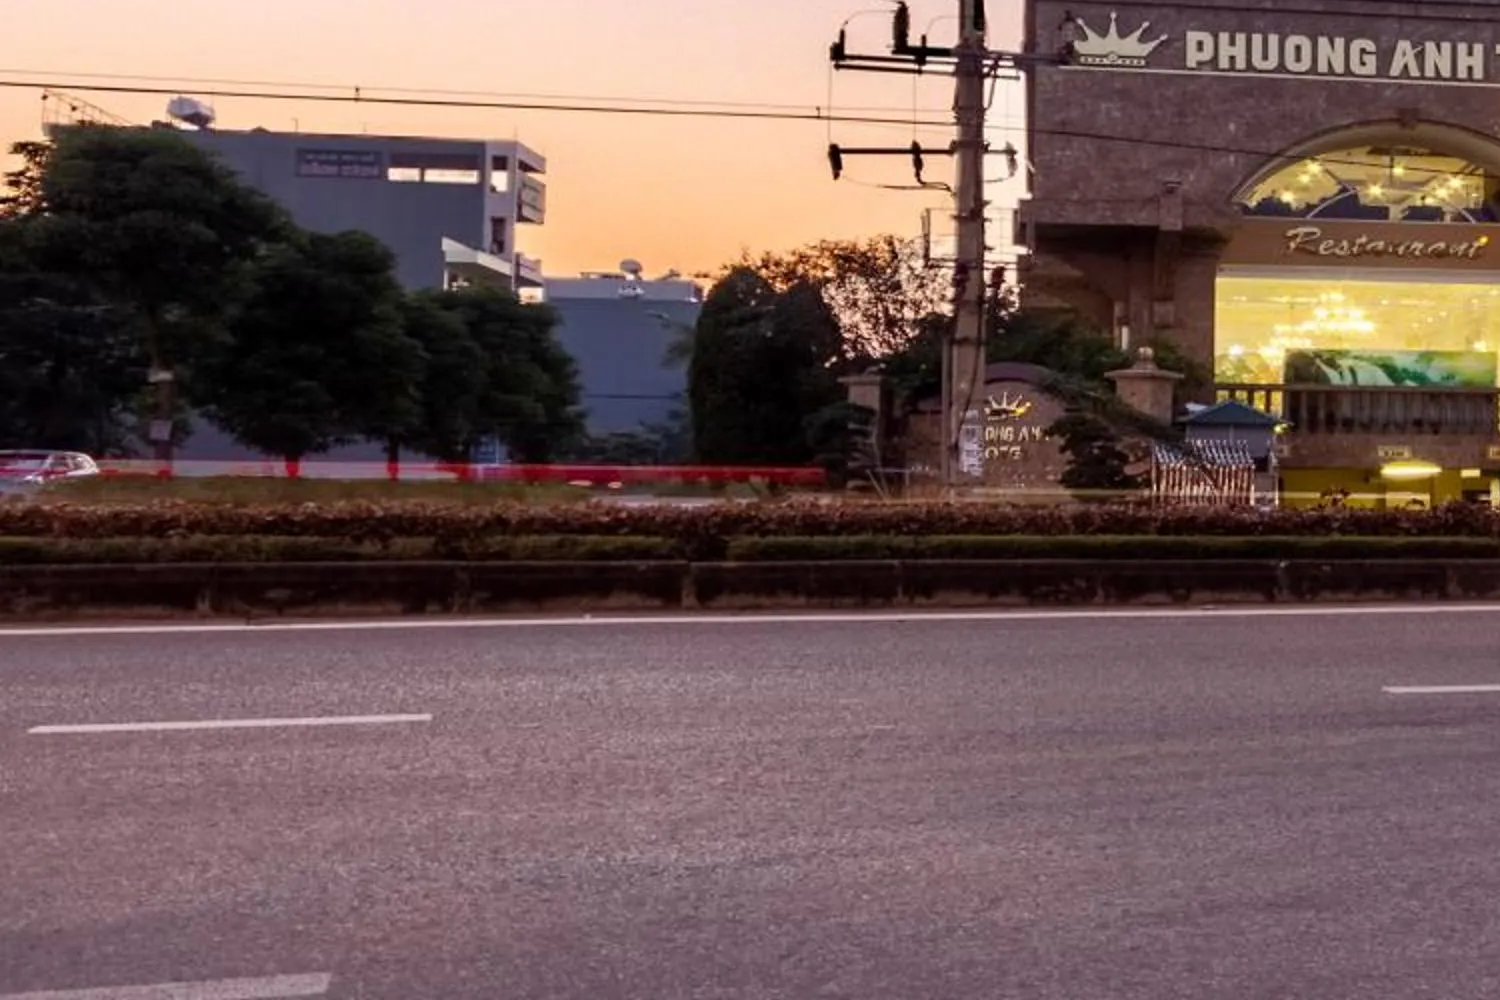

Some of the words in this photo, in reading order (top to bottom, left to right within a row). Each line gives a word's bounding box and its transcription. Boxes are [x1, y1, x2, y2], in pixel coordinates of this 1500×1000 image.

[1186, 31, 1377, 76] PHUONG
[1390, 40, 1484, 79] ANH
[1285, 226, 1487, 259] Restaurant
